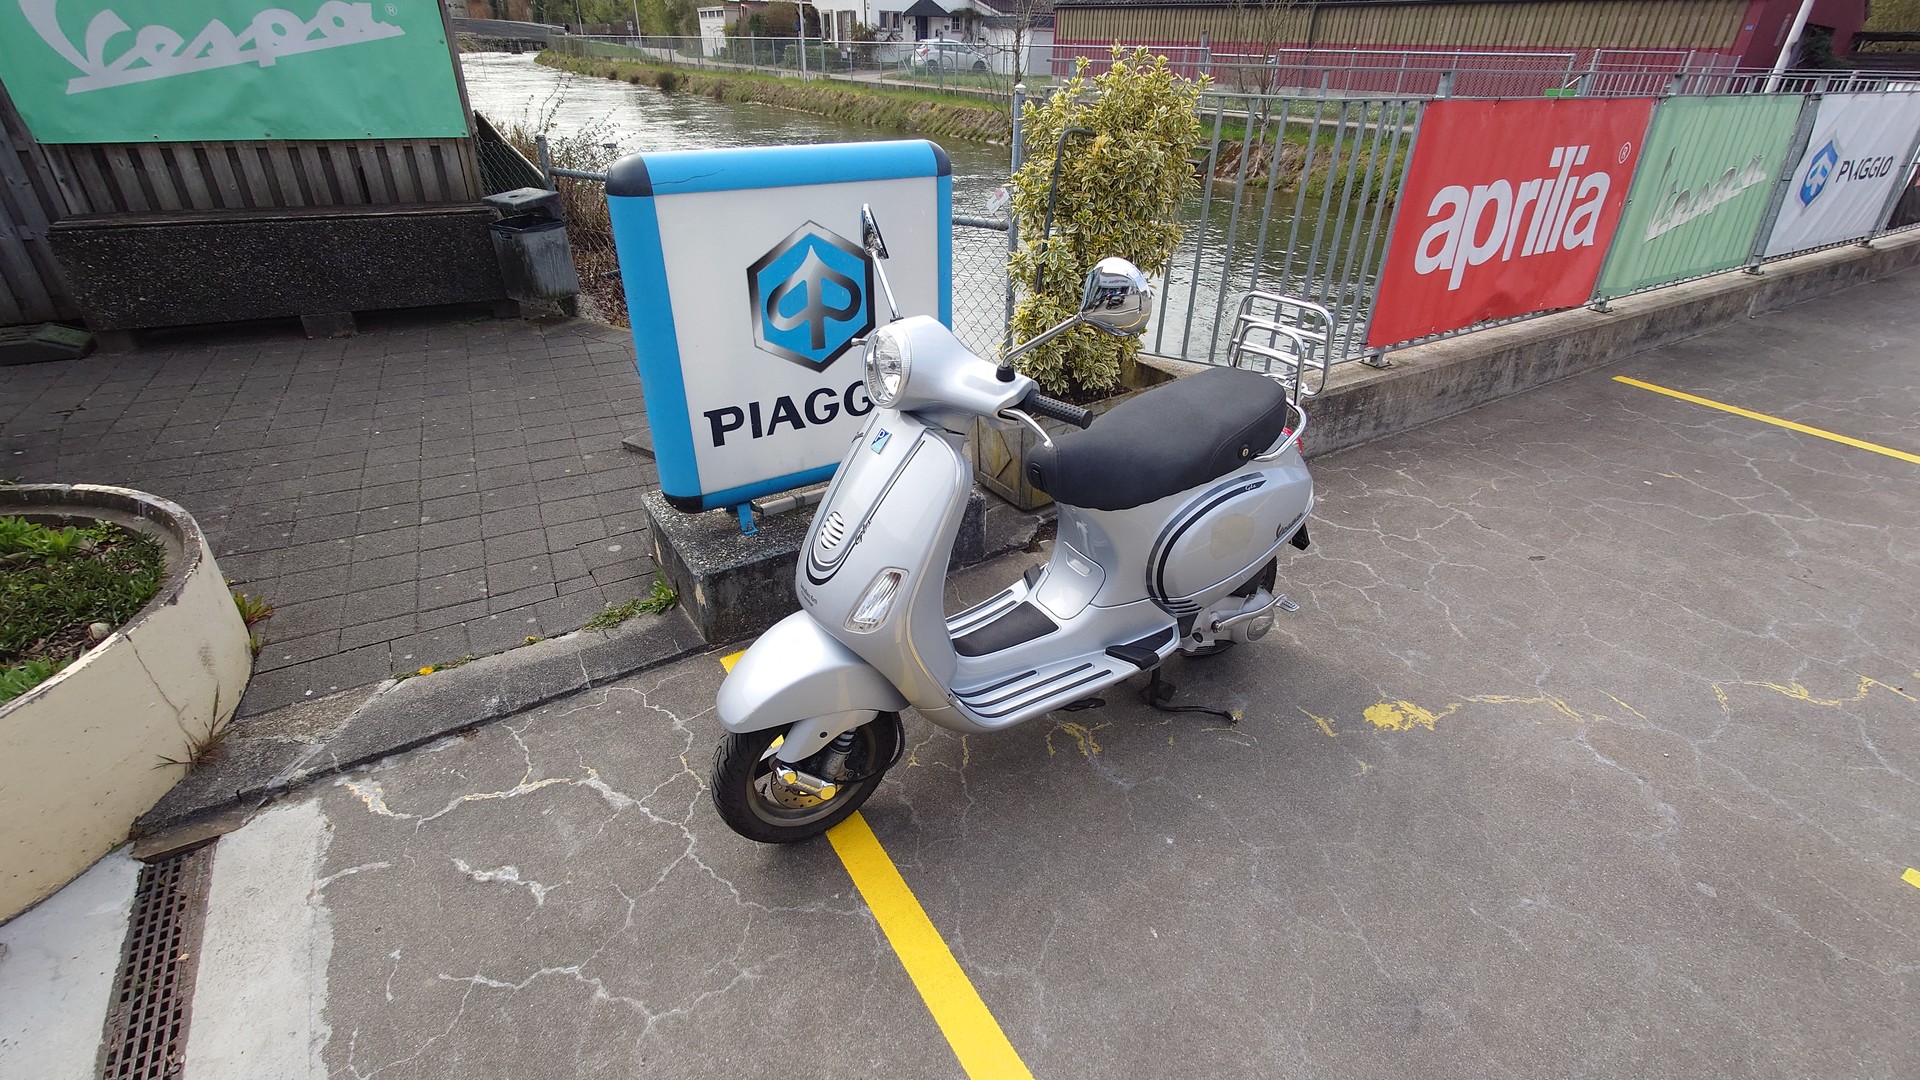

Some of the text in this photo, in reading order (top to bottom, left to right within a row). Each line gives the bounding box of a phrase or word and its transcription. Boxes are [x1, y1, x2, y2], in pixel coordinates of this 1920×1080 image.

[18, 0, 406, 95] Vespa
[1414, 145, 1610, 291] aprilia
[1643, 145, 1768, 244] Vespa
